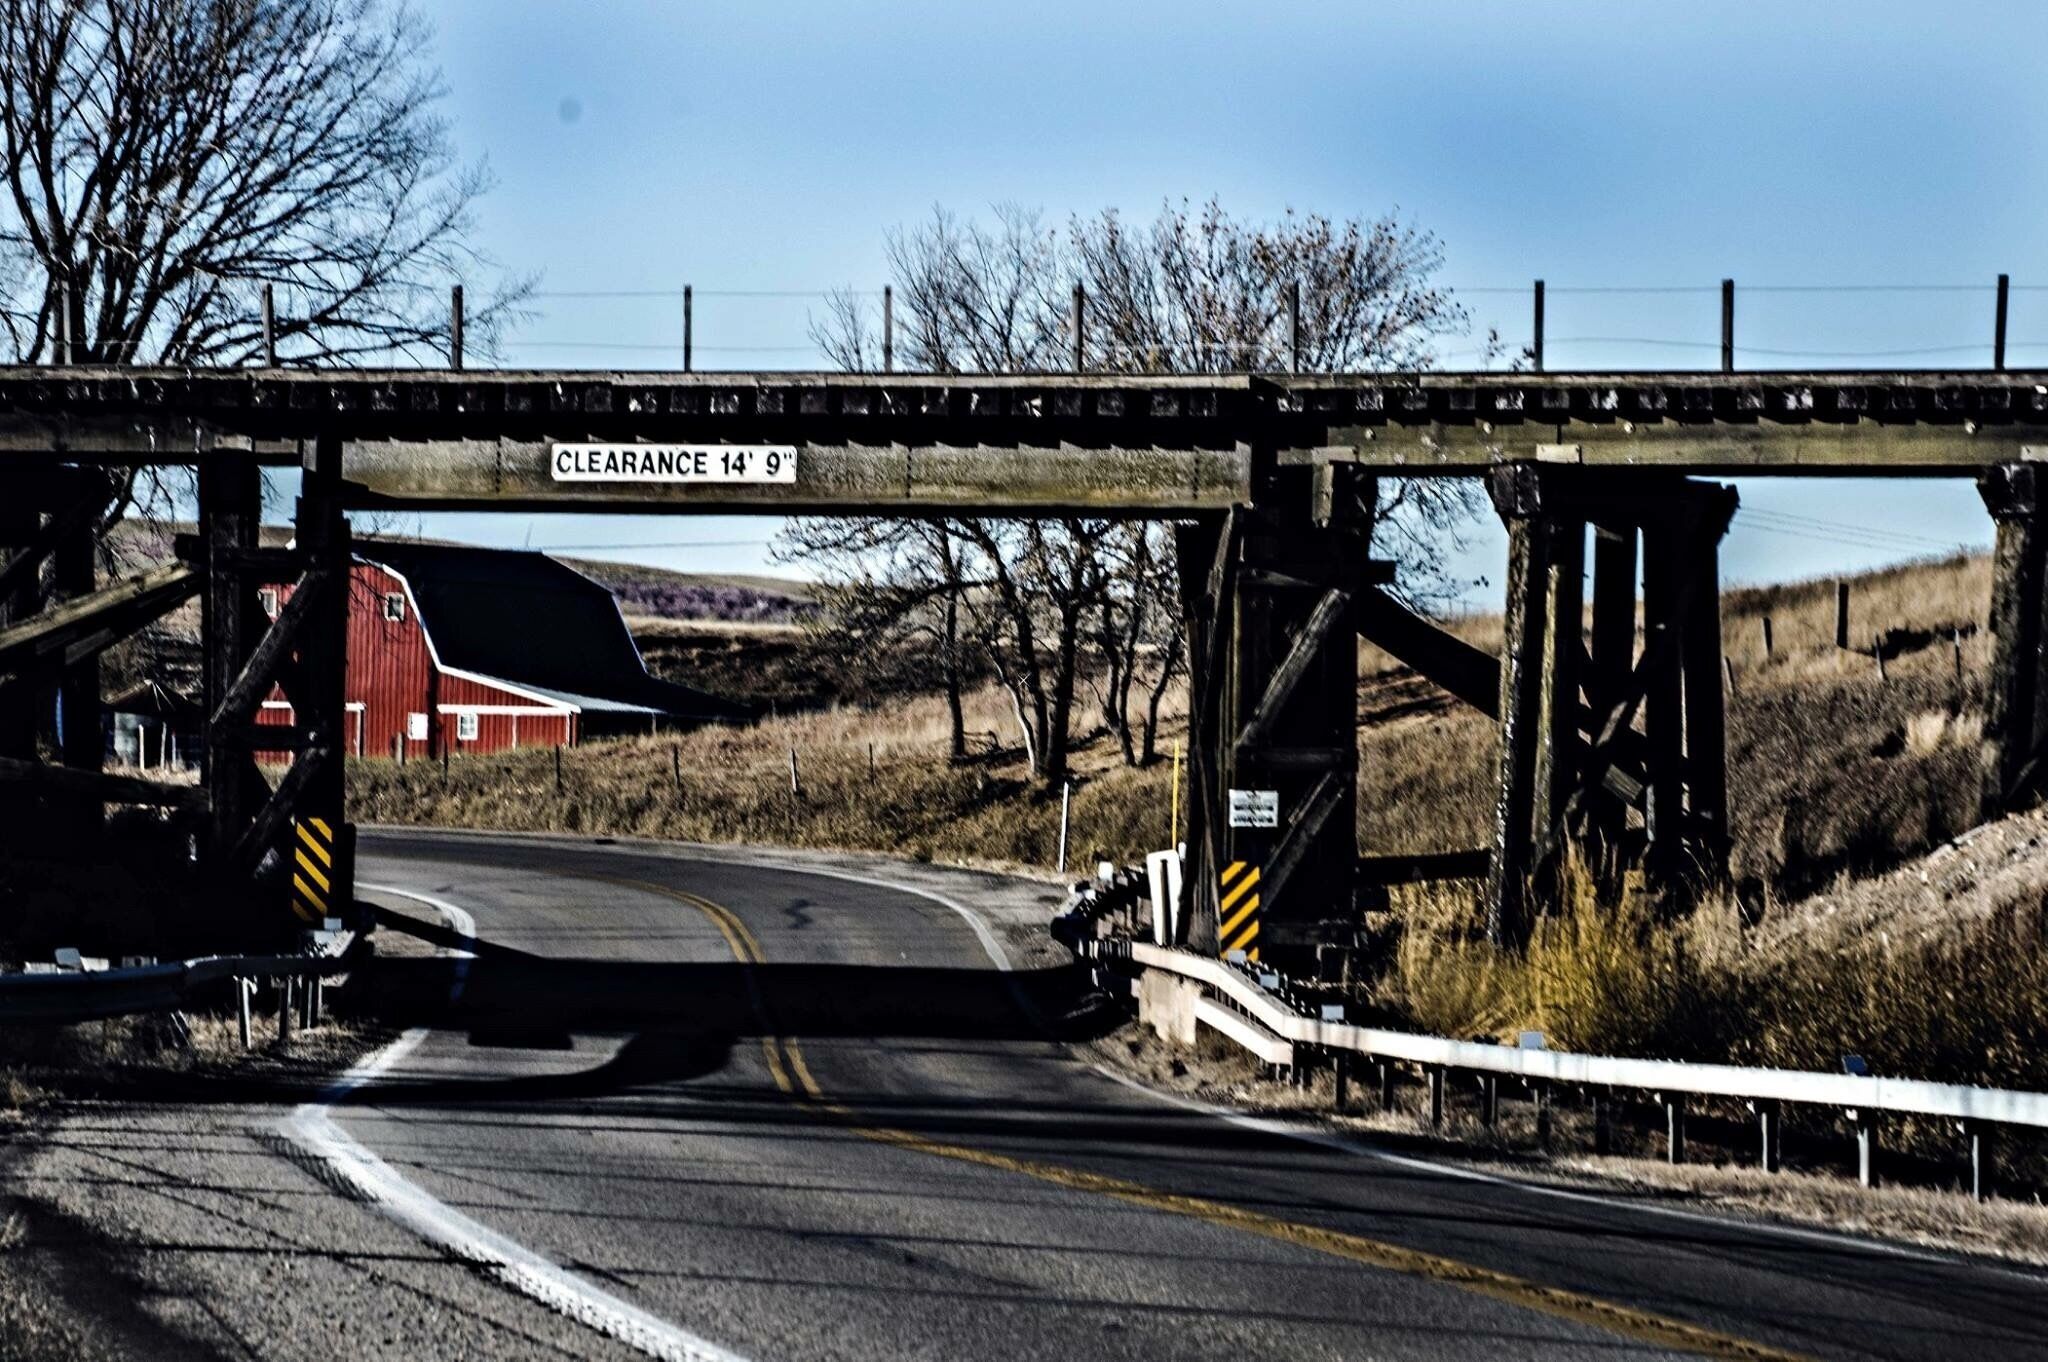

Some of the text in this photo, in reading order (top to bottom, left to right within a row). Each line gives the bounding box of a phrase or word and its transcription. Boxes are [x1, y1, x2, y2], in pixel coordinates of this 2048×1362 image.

[556, 450, 793, 476] CLEARANCE 14' 9"
